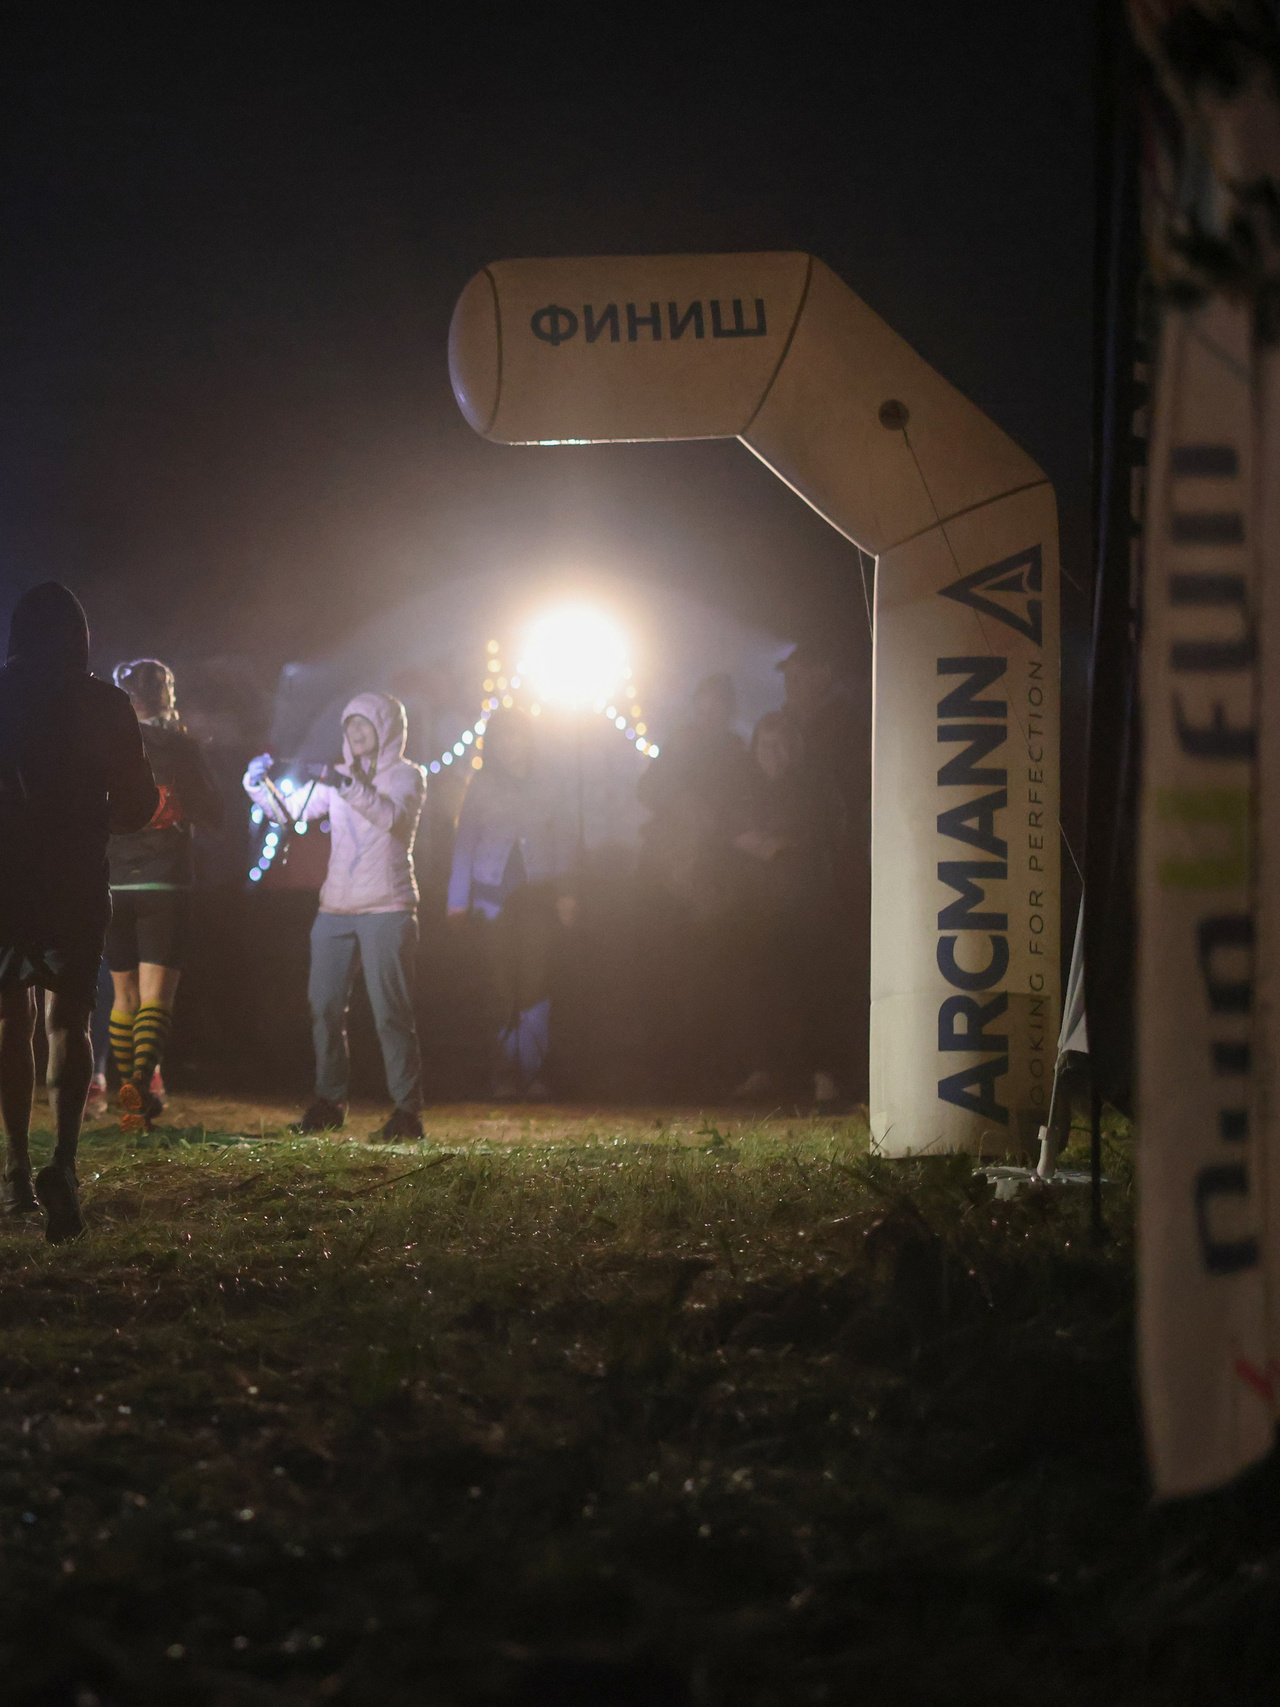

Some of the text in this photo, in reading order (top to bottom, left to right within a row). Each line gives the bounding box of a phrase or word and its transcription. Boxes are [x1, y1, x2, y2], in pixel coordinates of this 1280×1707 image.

[530, 298, 768, 347] ФИНИШ
[936, 655, 1010, 1125] ARCMANN
[1028, 661, 1045, 1112] OOKING FOR PERFECTION
